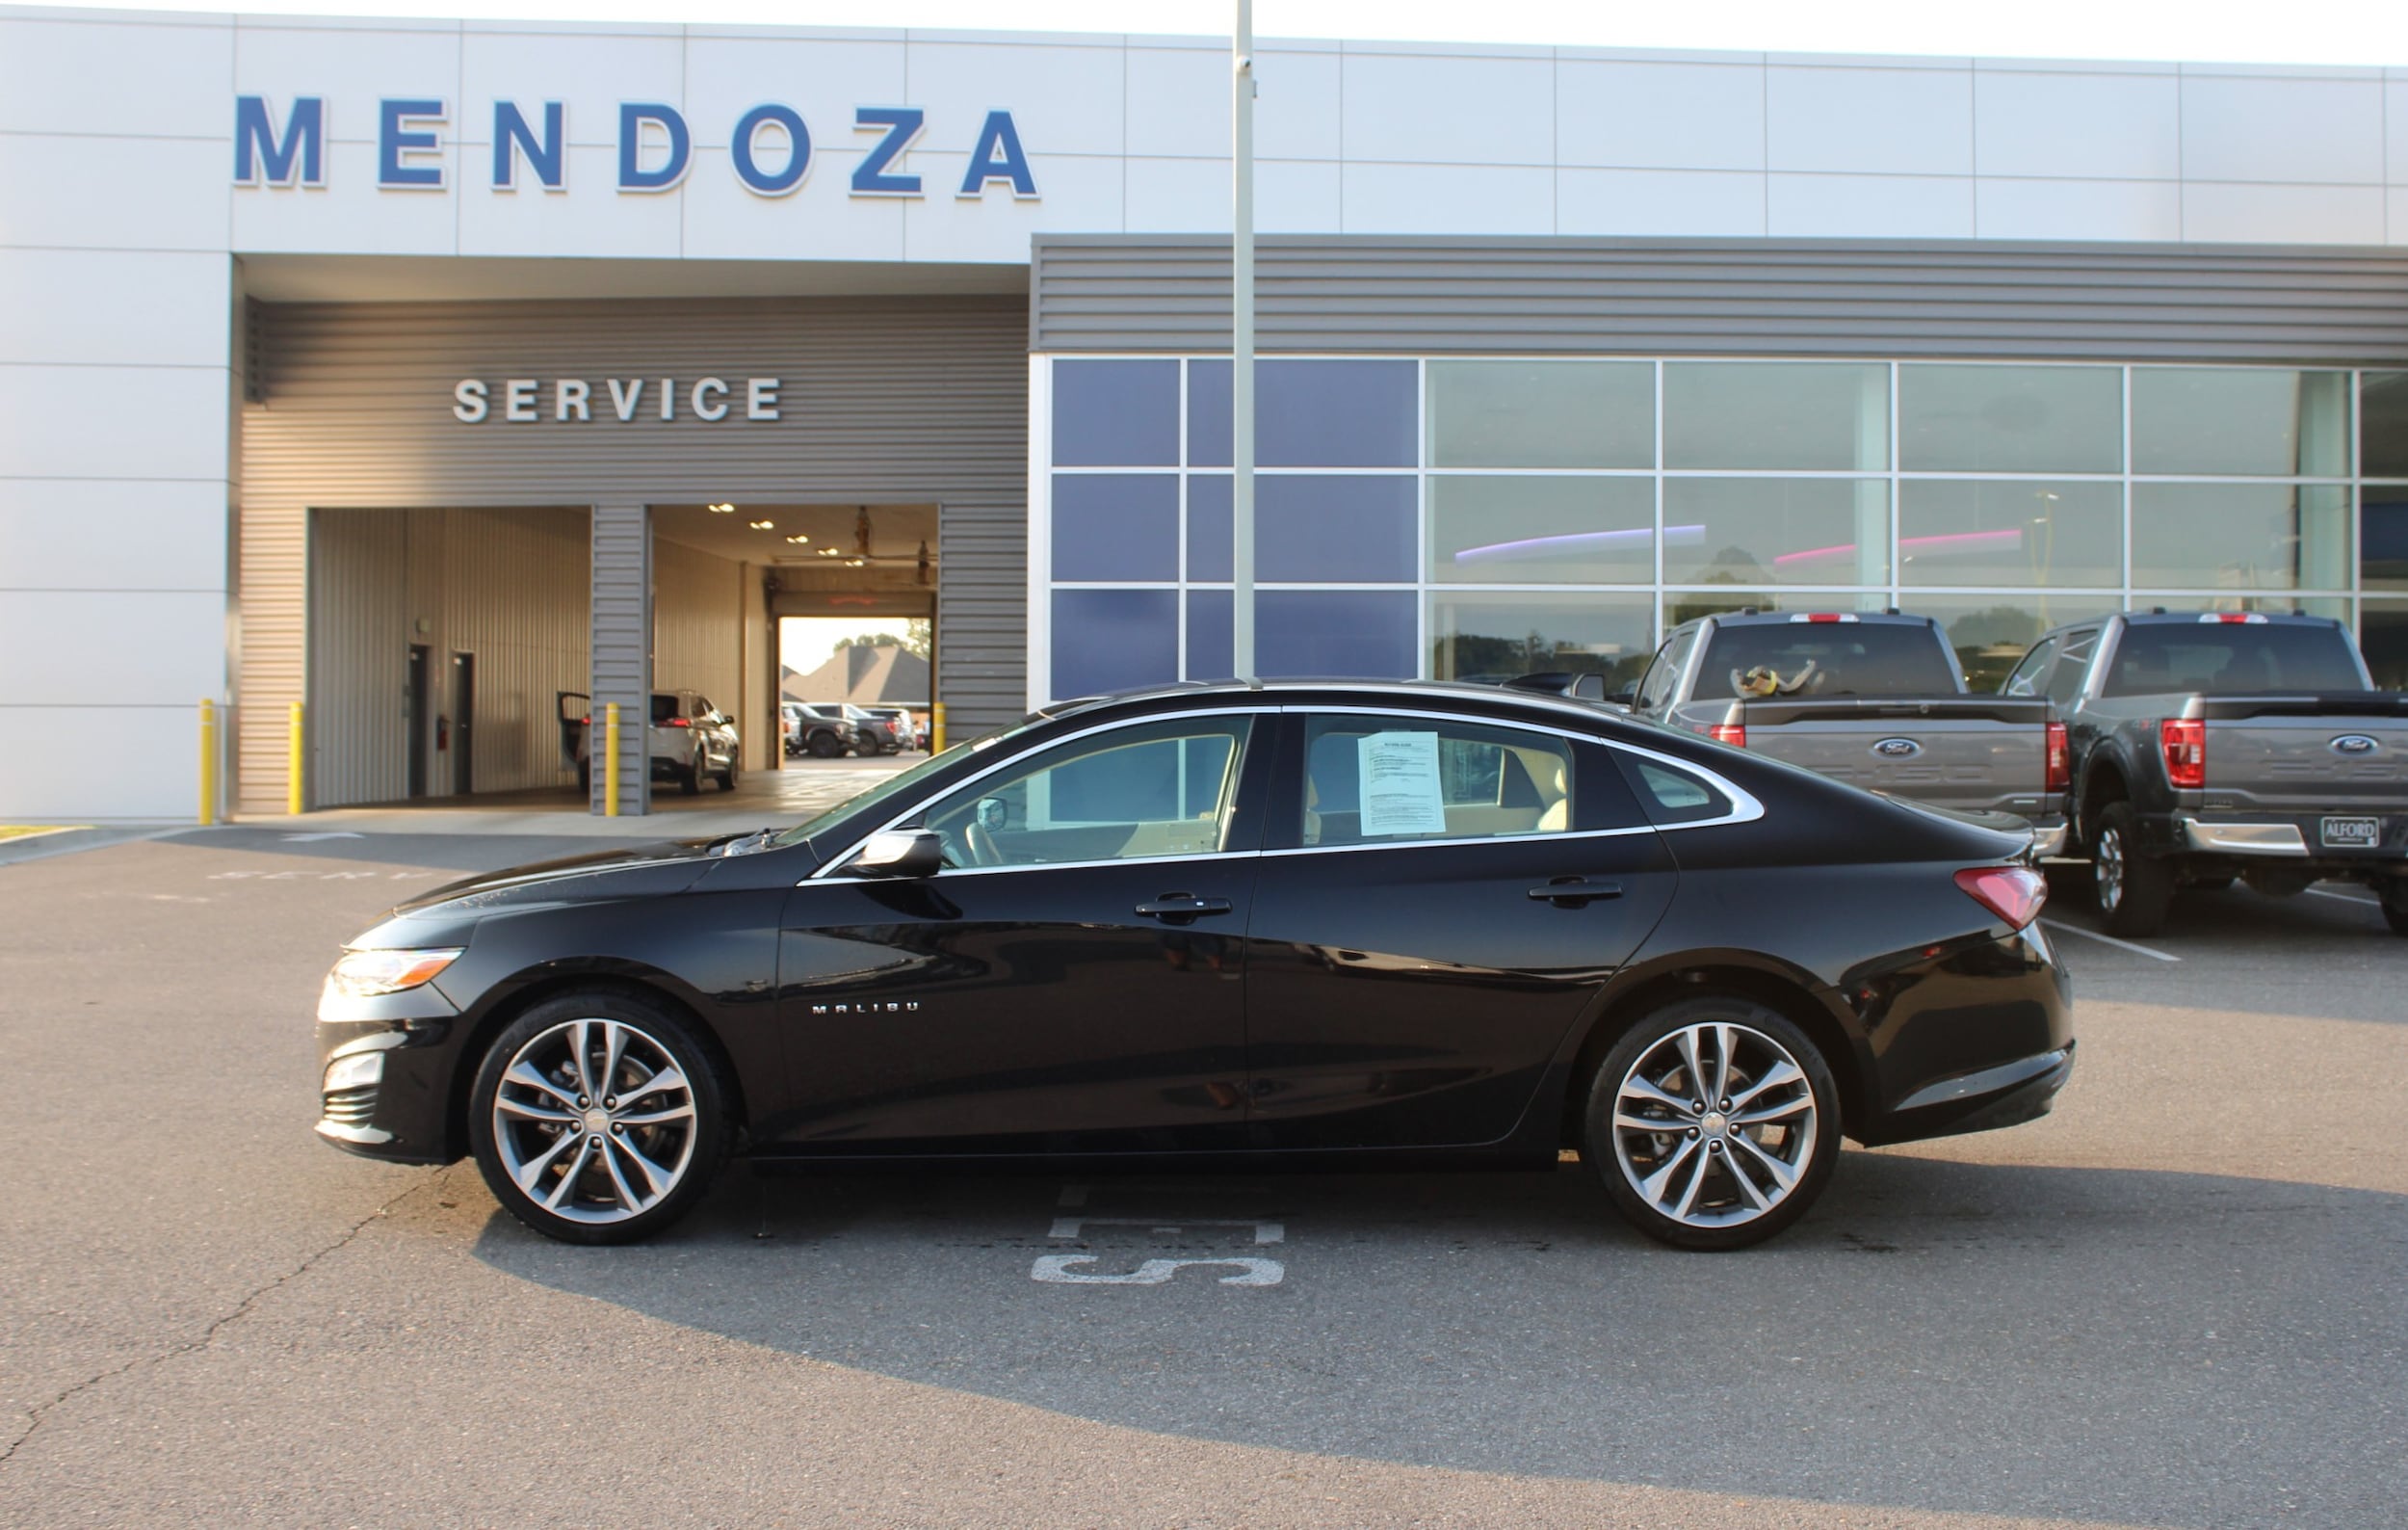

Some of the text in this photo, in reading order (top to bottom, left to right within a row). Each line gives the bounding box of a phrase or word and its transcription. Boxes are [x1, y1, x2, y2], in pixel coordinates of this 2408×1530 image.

[234, 94, 1040, 200] MENDOZA
[453, 377, 782, 423] SERVICE
[2326, 822, 2375, 837] ALFORD
[812, 1002, 919, 1015] MALIBU
